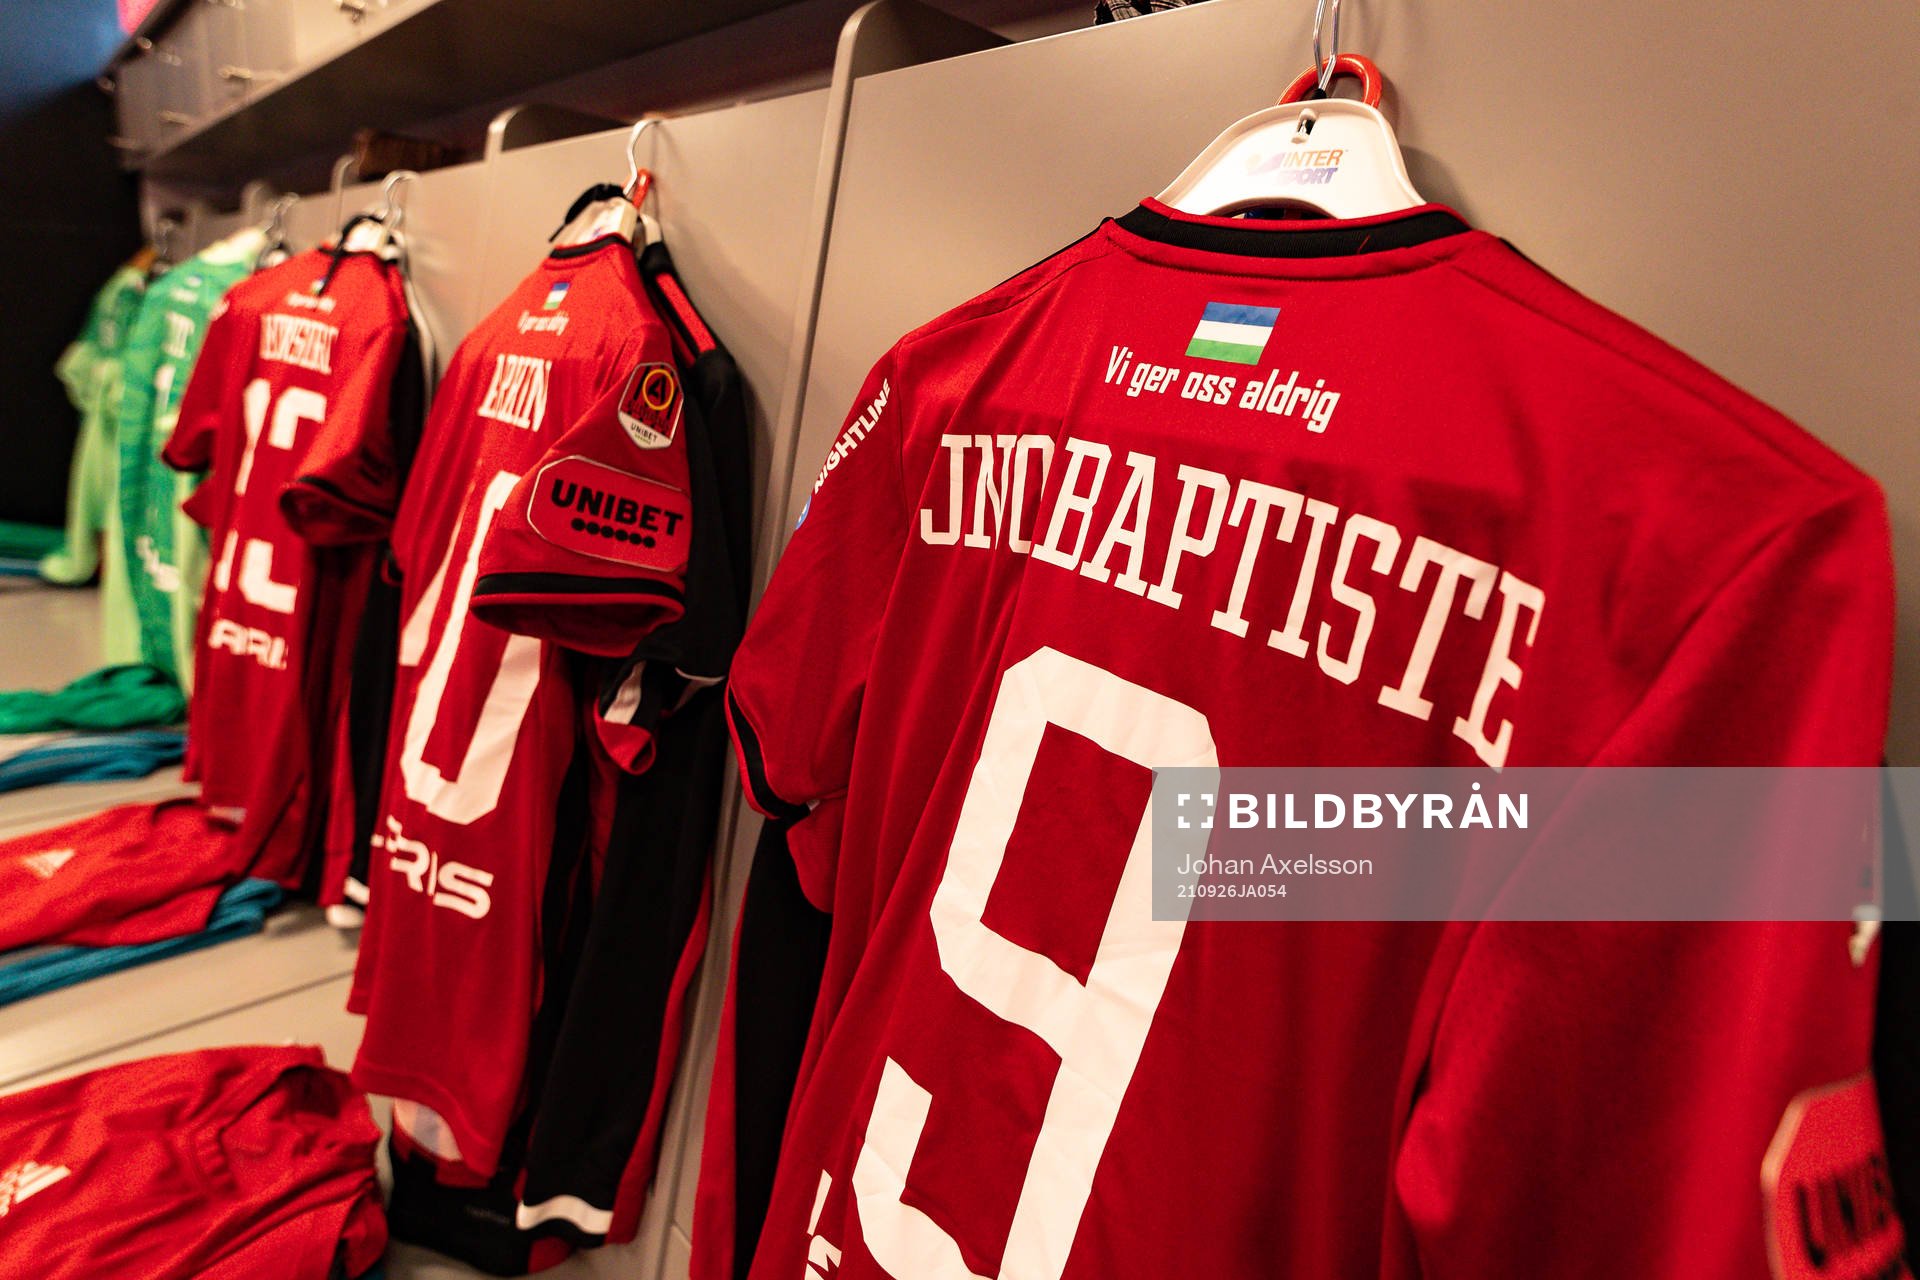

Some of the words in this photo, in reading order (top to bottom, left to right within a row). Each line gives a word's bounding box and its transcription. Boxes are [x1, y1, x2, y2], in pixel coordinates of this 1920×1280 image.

[1283, 149, 1344, 167] INTER
[1104, 345, 1134, 385] Vi
[1126, 362, 1180, 398] ger
[1180, 371, 1237, 406] oss
[1239, 368, 1341, 434] aldrig
[814, 378, 891, 495] NIGHTLINE
[551, 479, 684, 536] UNIBET
[852, 646, 1221, 1280] 9
